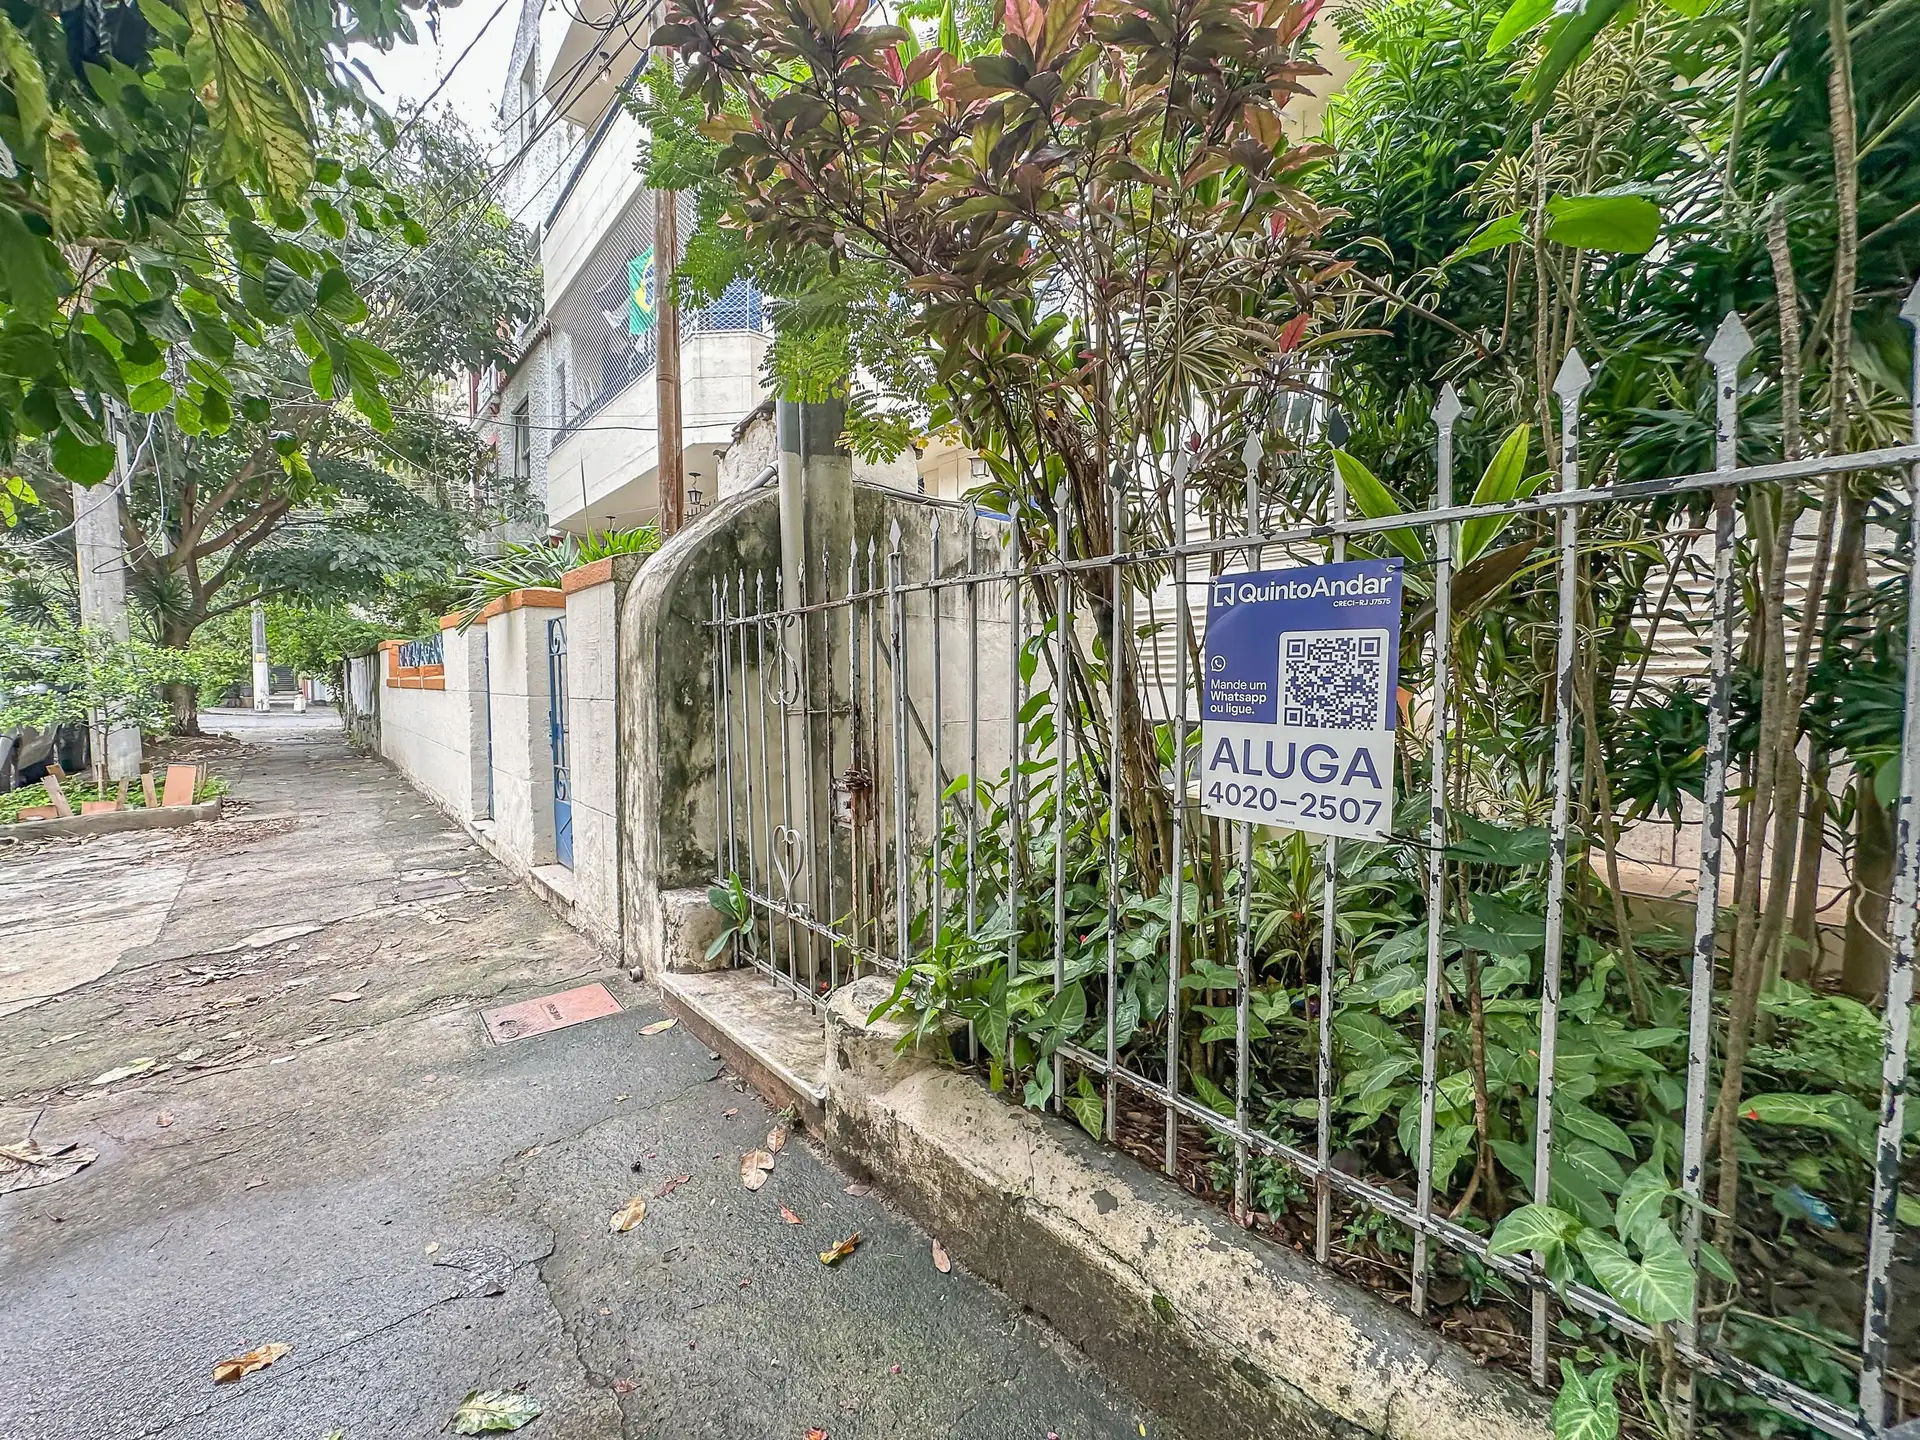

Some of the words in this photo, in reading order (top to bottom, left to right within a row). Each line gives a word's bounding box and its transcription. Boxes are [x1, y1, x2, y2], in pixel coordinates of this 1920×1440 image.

[1238, 574, 1392, 603] QuintoAndar
[1332, 599, 1369, 607] CRECI-RJ
[1210, 679, 1247, 690] Mande
[1249, 682, 1267, 690] um
[1210, 691, 1267, 703] Whatsapp
[1210, 705, 1224, 713] ou
[1225, 704, 1255, 715] ligue.
[1208, 737, 1383, 789] ALUGA
[1207, 781, 1382, 825] 4020-2507
